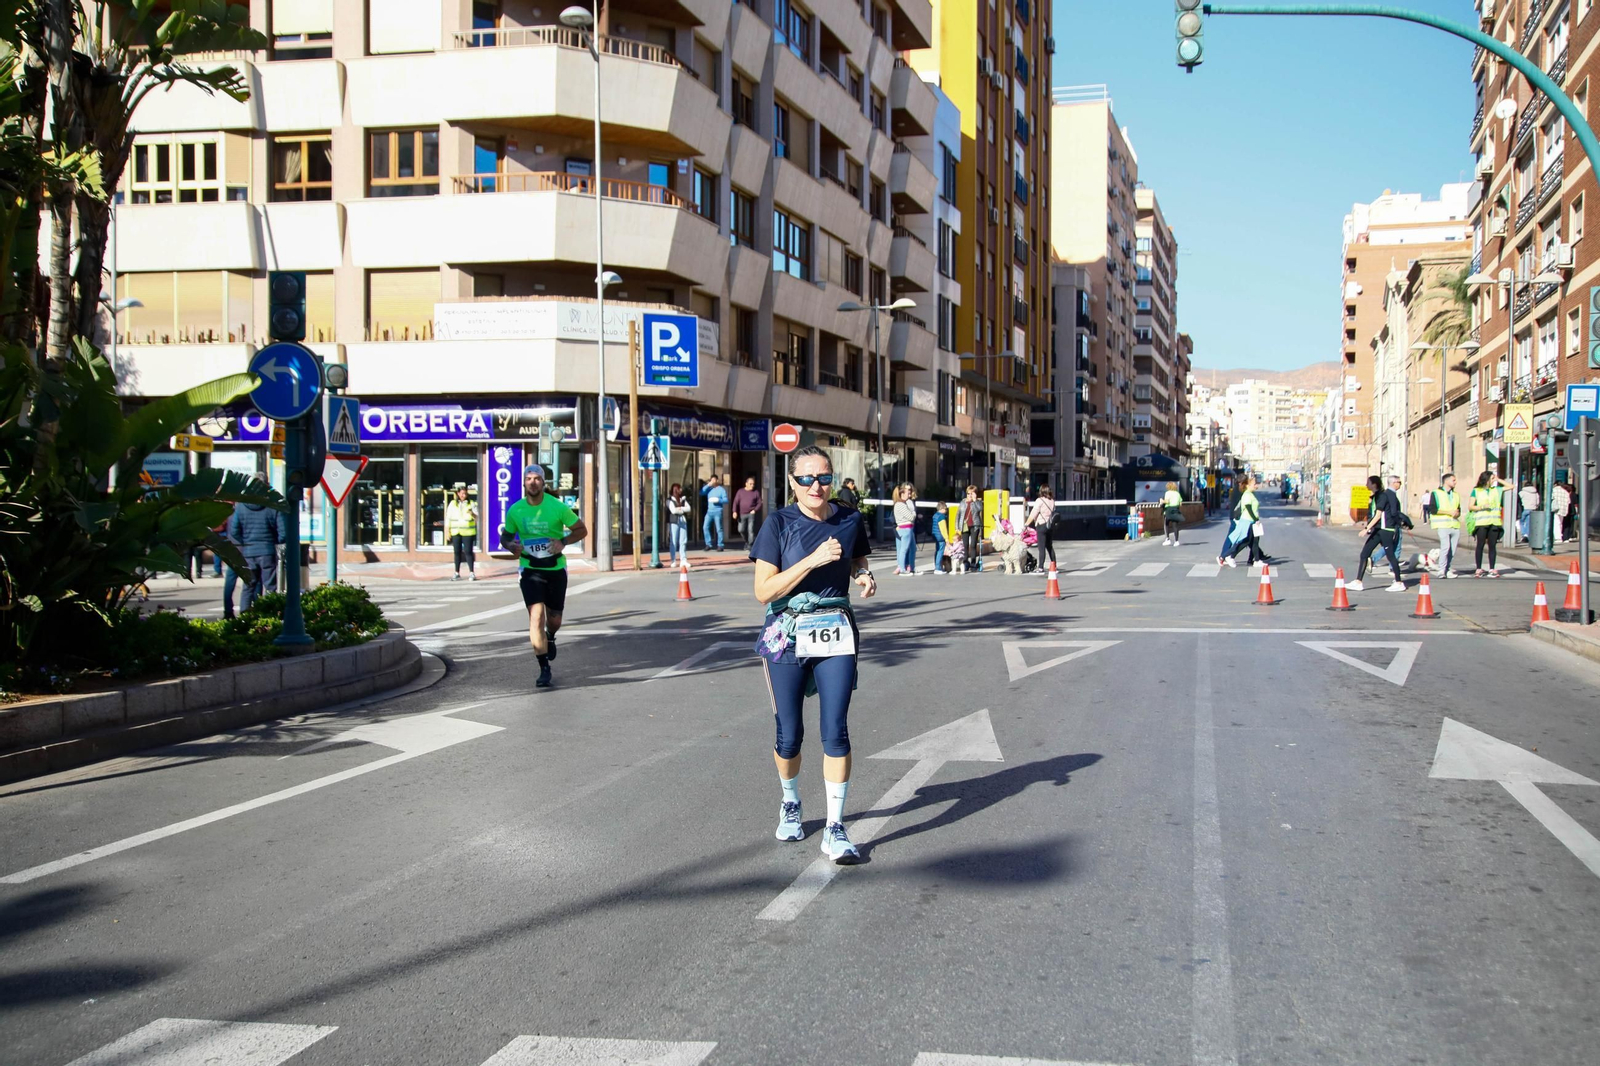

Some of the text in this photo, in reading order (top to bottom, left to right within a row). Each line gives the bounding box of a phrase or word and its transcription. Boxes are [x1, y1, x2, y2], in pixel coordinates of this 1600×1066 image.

[652, 322, 680, 361] P
[529, 543, 547, 553] 185
[808, 627, 841, 643] 161
